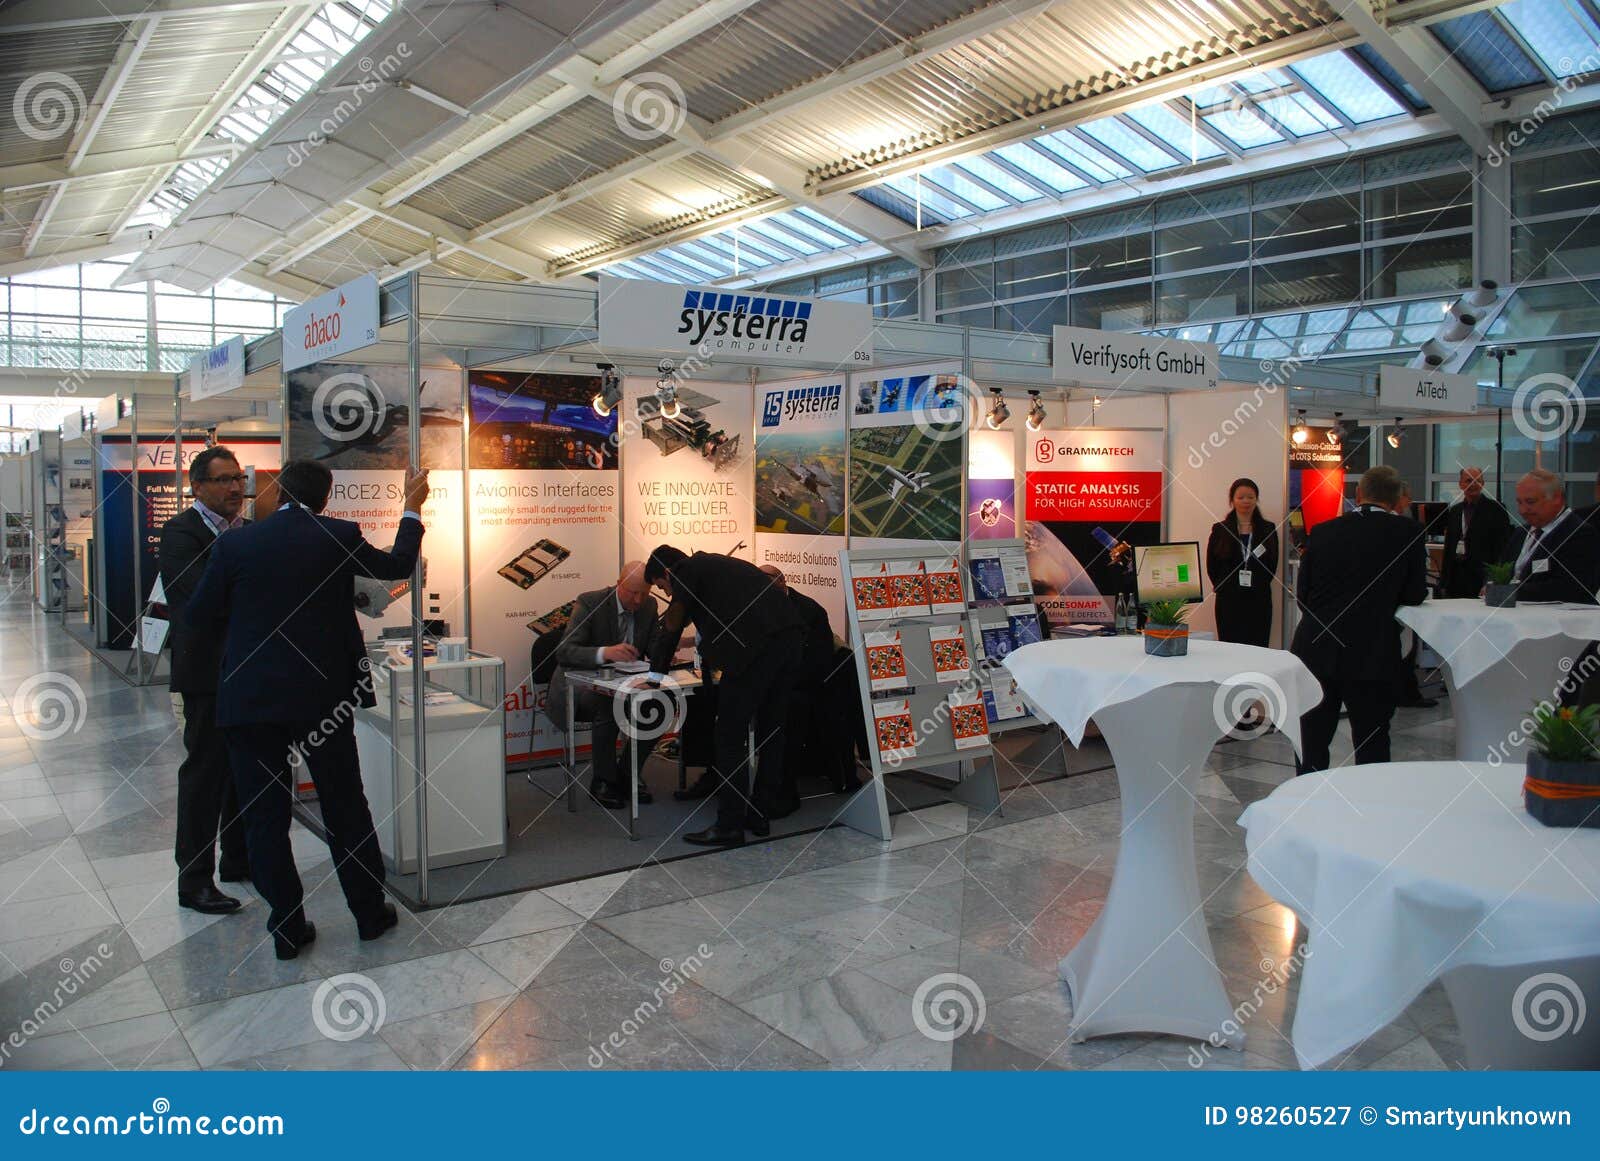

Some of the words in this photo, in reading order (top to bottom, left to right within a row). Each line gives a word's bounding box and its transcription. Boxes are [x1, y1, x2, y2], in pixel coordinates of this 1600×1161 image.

[304, 312, 341, 350] abaco
[678, 305, 809, 346] systerra
[704, 337, 804, 354] computer
[854, 350, 871, 362] D3a
[1071, 342, 1151, 374] Verifysoft
[1156, 351, 1206, 375] GmbH
[1415, 381, 1448, 400] AiTech
[765, 392, 783, 416] 15
[785, 393, 840, 421] systerra
[1058, 447, 1134, 456] GRAMMATECH
[386, 484, 448, 503] Syem
[475, 483, 538, 498] Avionics
[543, 481, 614, 497] Interfaces
[638, 482, 660, 497] WE
[665, 482, 737, 497] INNOVATE.
[1035, 483, 1076, 495] STATIC
[1080, 483, 1140, 494] ANALYSIS
[517, 504, 539, 514] small
[541, 504, 556, 514] and
[558, 504, 585, 516] rugged
[587, 503, 599, 513] for
[600, 504, 613, 513] the
[644, 502, 667, 516] WE
[671, 501, 732, 516] DELIVER.
[1035, 498, 1055, 508] FOR
[1058, 498, 1085, 508] HIGH
[1088, 498, 1152, 509] ASSURANCE
[324, 509, 348, 519] Open
[481, 517, 503, 526] most
[505, 516, 550, 527] demanding
[640, 521, 669, 536] YOU
[673, 519, 740, 535] SUCCEED.
[765, 549, 801, 564] Embedded
[803, 552, 838, 567] Solutions
[808, 572, 838, 588] Defence
